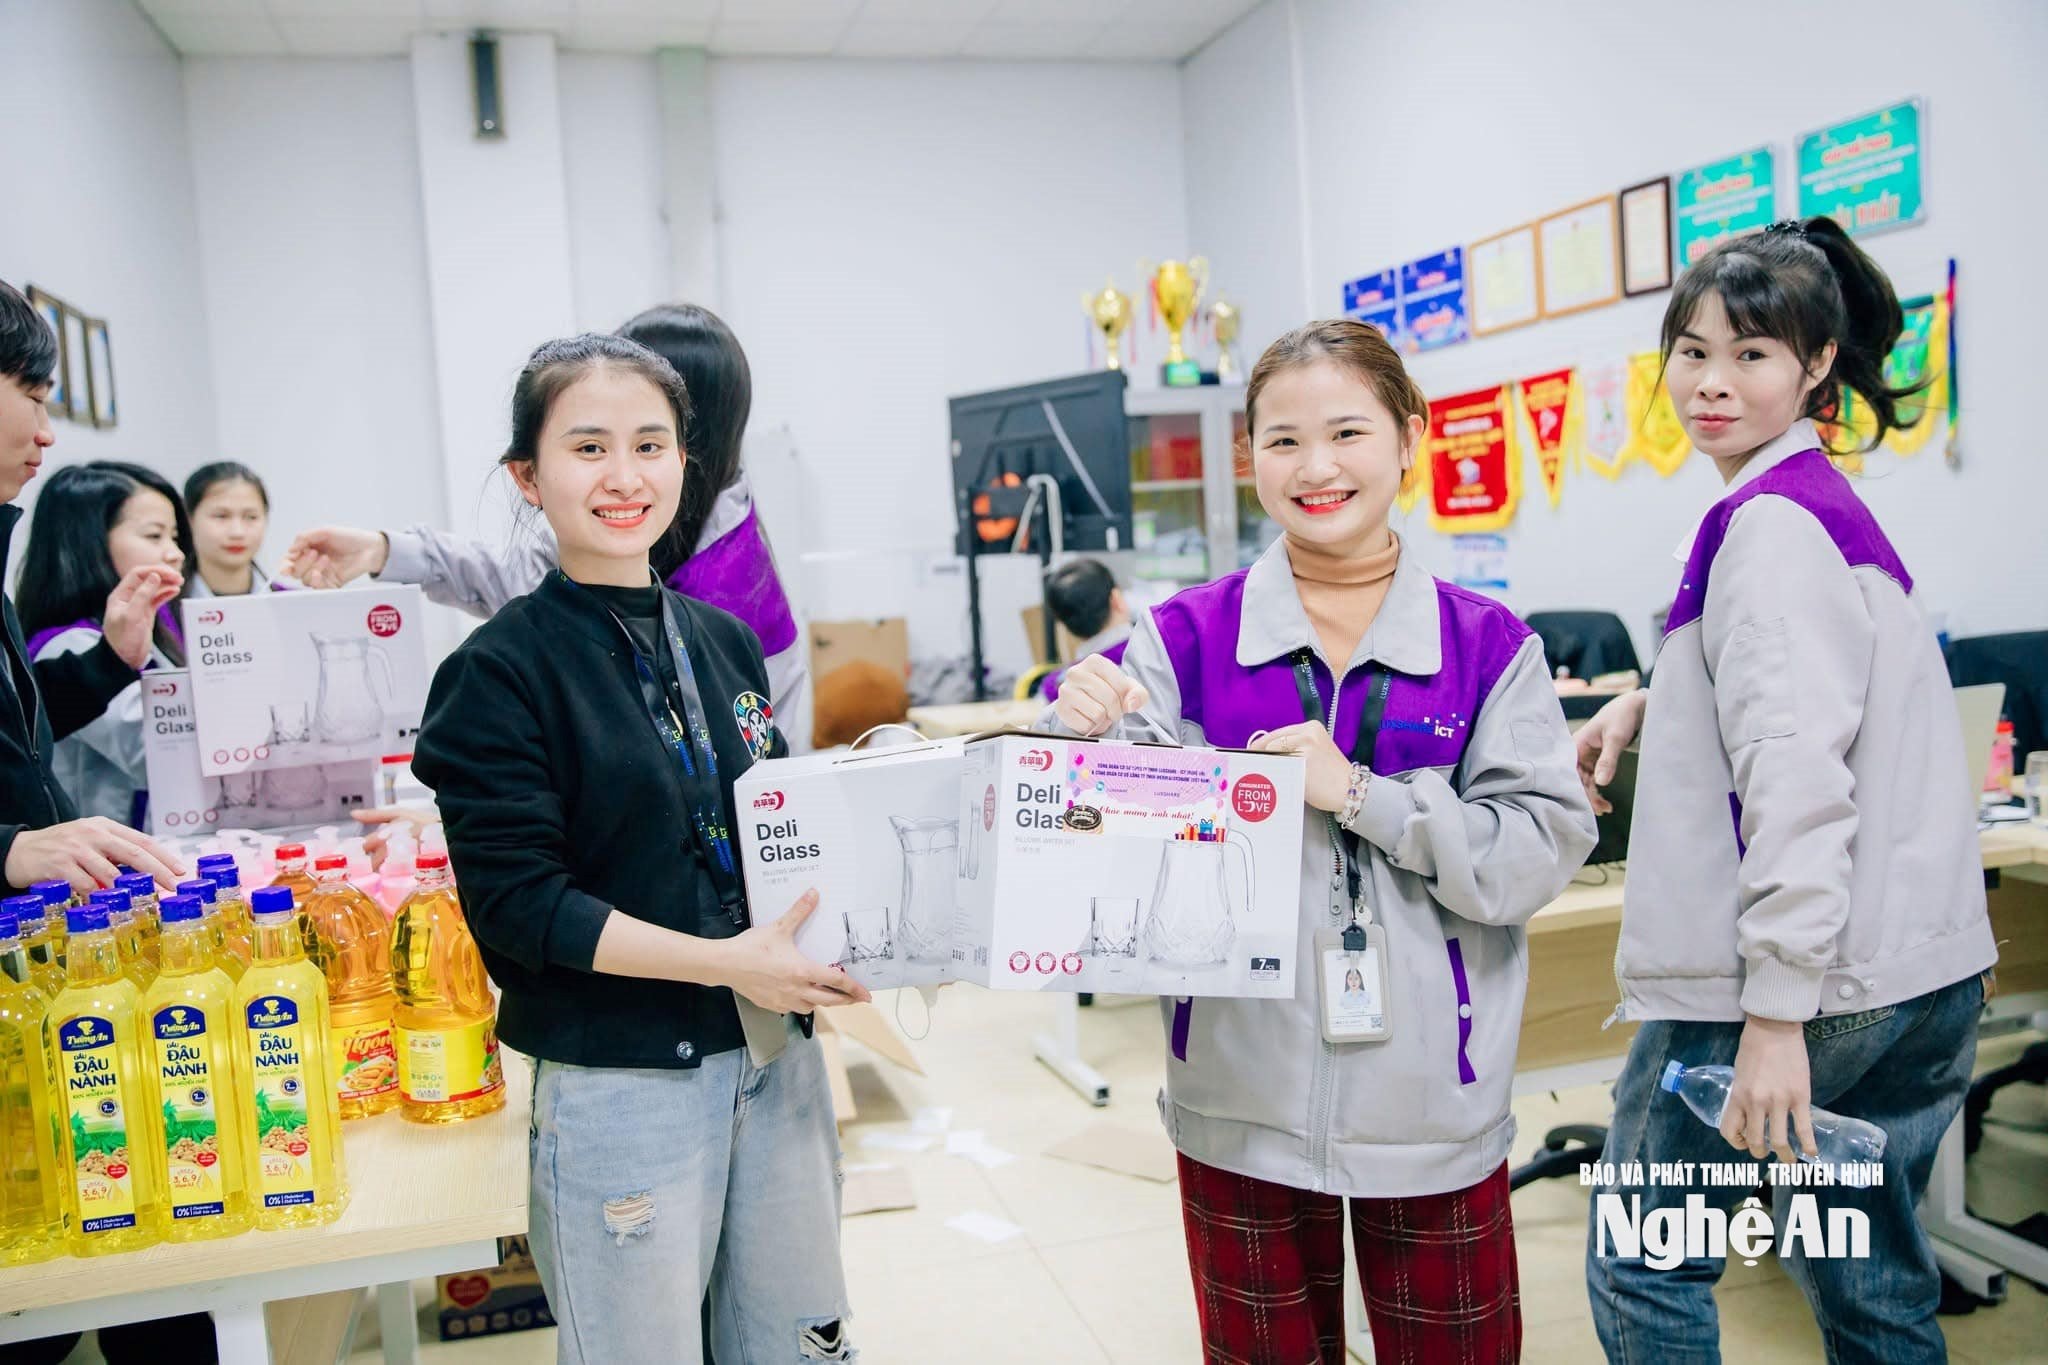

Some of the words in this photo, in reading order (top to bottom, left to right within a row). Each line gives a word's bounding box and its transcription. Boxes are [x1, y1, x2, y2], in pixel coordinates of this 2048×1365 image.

[200, 632, 234, 648] Deli
[202, 651, 253, 666] Glass
[154, 704, 187, 718] Deli
[156, 721, 195, 735] Glas
[1017, 783, 1061, 804] Deli
[1237, 789, 1271, 801] FROM
[1237, 800, 1271, 813] LOVE
[1016, 808, 1064, 830] Glas
[756, 819, 798, 841] Deli
[760, 844, 821, 862] Glass
[1259, 958, 1267, 970] 7
[260, 1035, 292, 1052] ĐẬU
[167, 1045, 200, 1062] ĐẬU
[255, 1051, 299, 1068] NÀNH
[74, 1056, 109, 1073] ĐẬU
[162, 1061, 207, 1078] NÀNH
[69, 1073, 116, 1090] NÀNH
[268, 1196, 281, 1205] 0%
[176, 1208, 190, 1217] 0%
[86, 1221, 100, 1231] 0%
